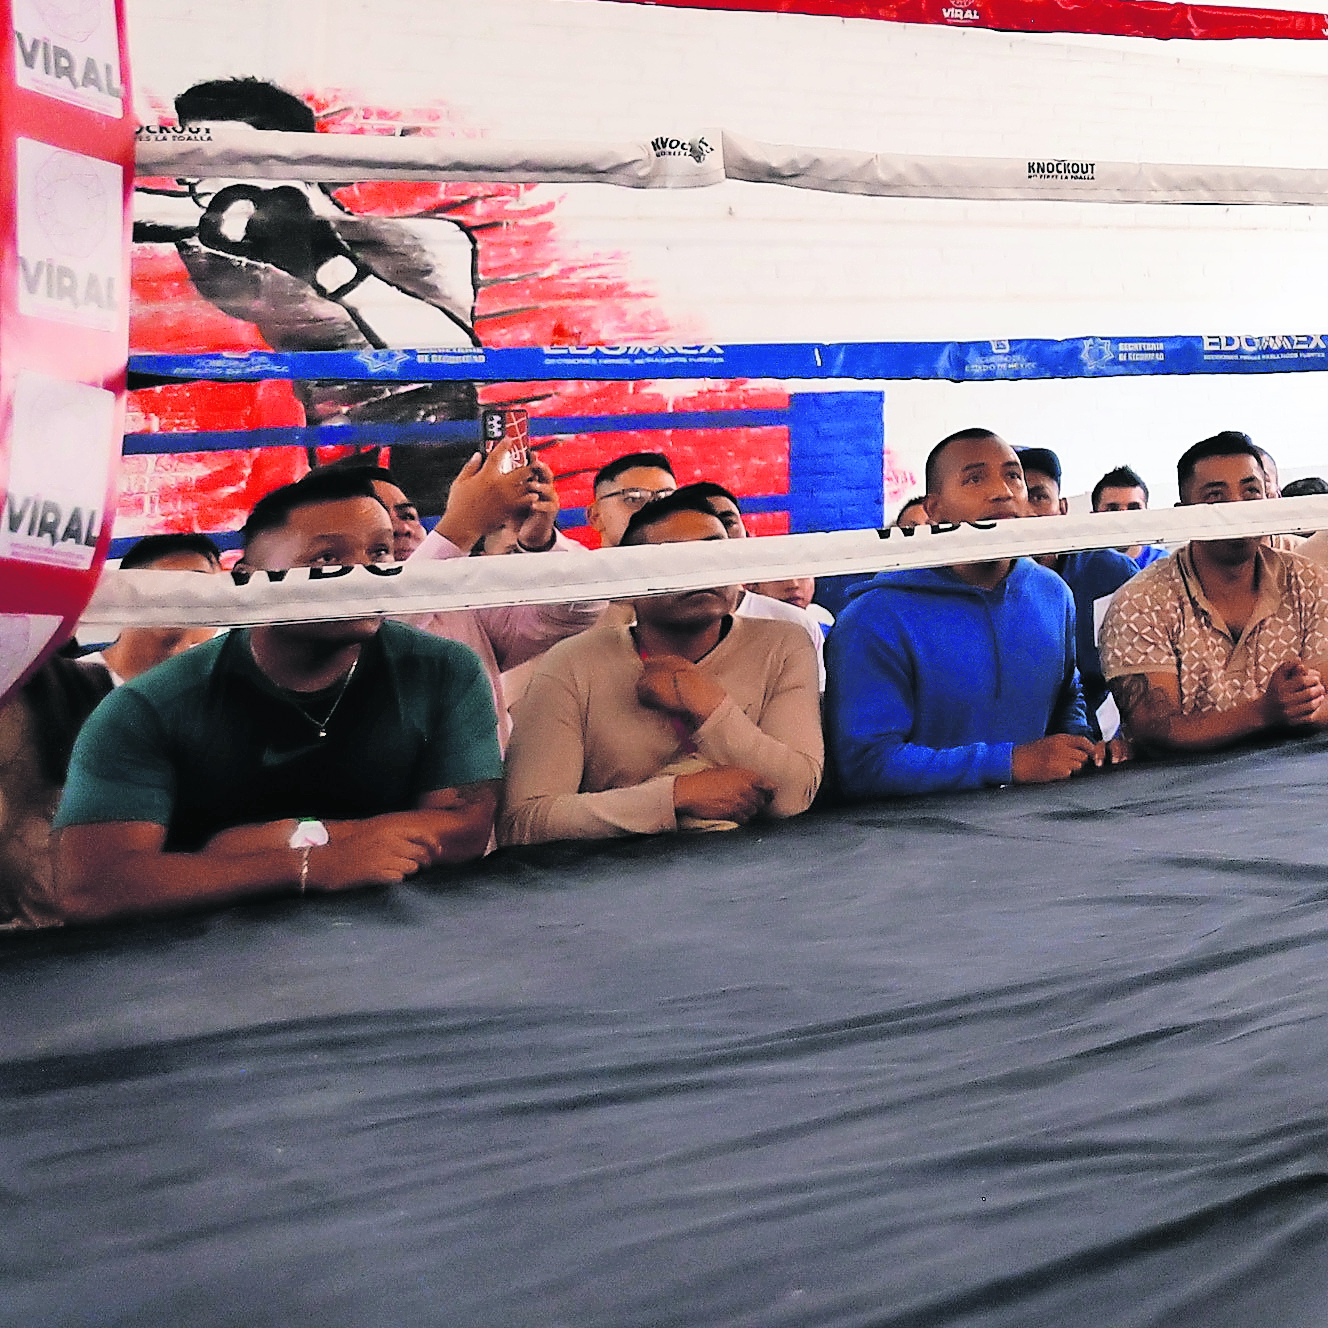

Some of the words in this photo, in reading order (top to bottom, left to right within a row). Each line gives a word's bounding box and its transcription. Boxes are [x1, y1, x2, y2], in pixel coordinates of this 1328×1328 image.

[942, 7, 980, 20] VIRAL
[15, 30, 123, 98] VIRAL
[1027, 161, 1096, 175] KNOCKOUT
[19, 255, 118, 312] VIRAL
[1203, 334, 1327, 352] EDOMEX
[7, 491, 100, 547] VIRAL
